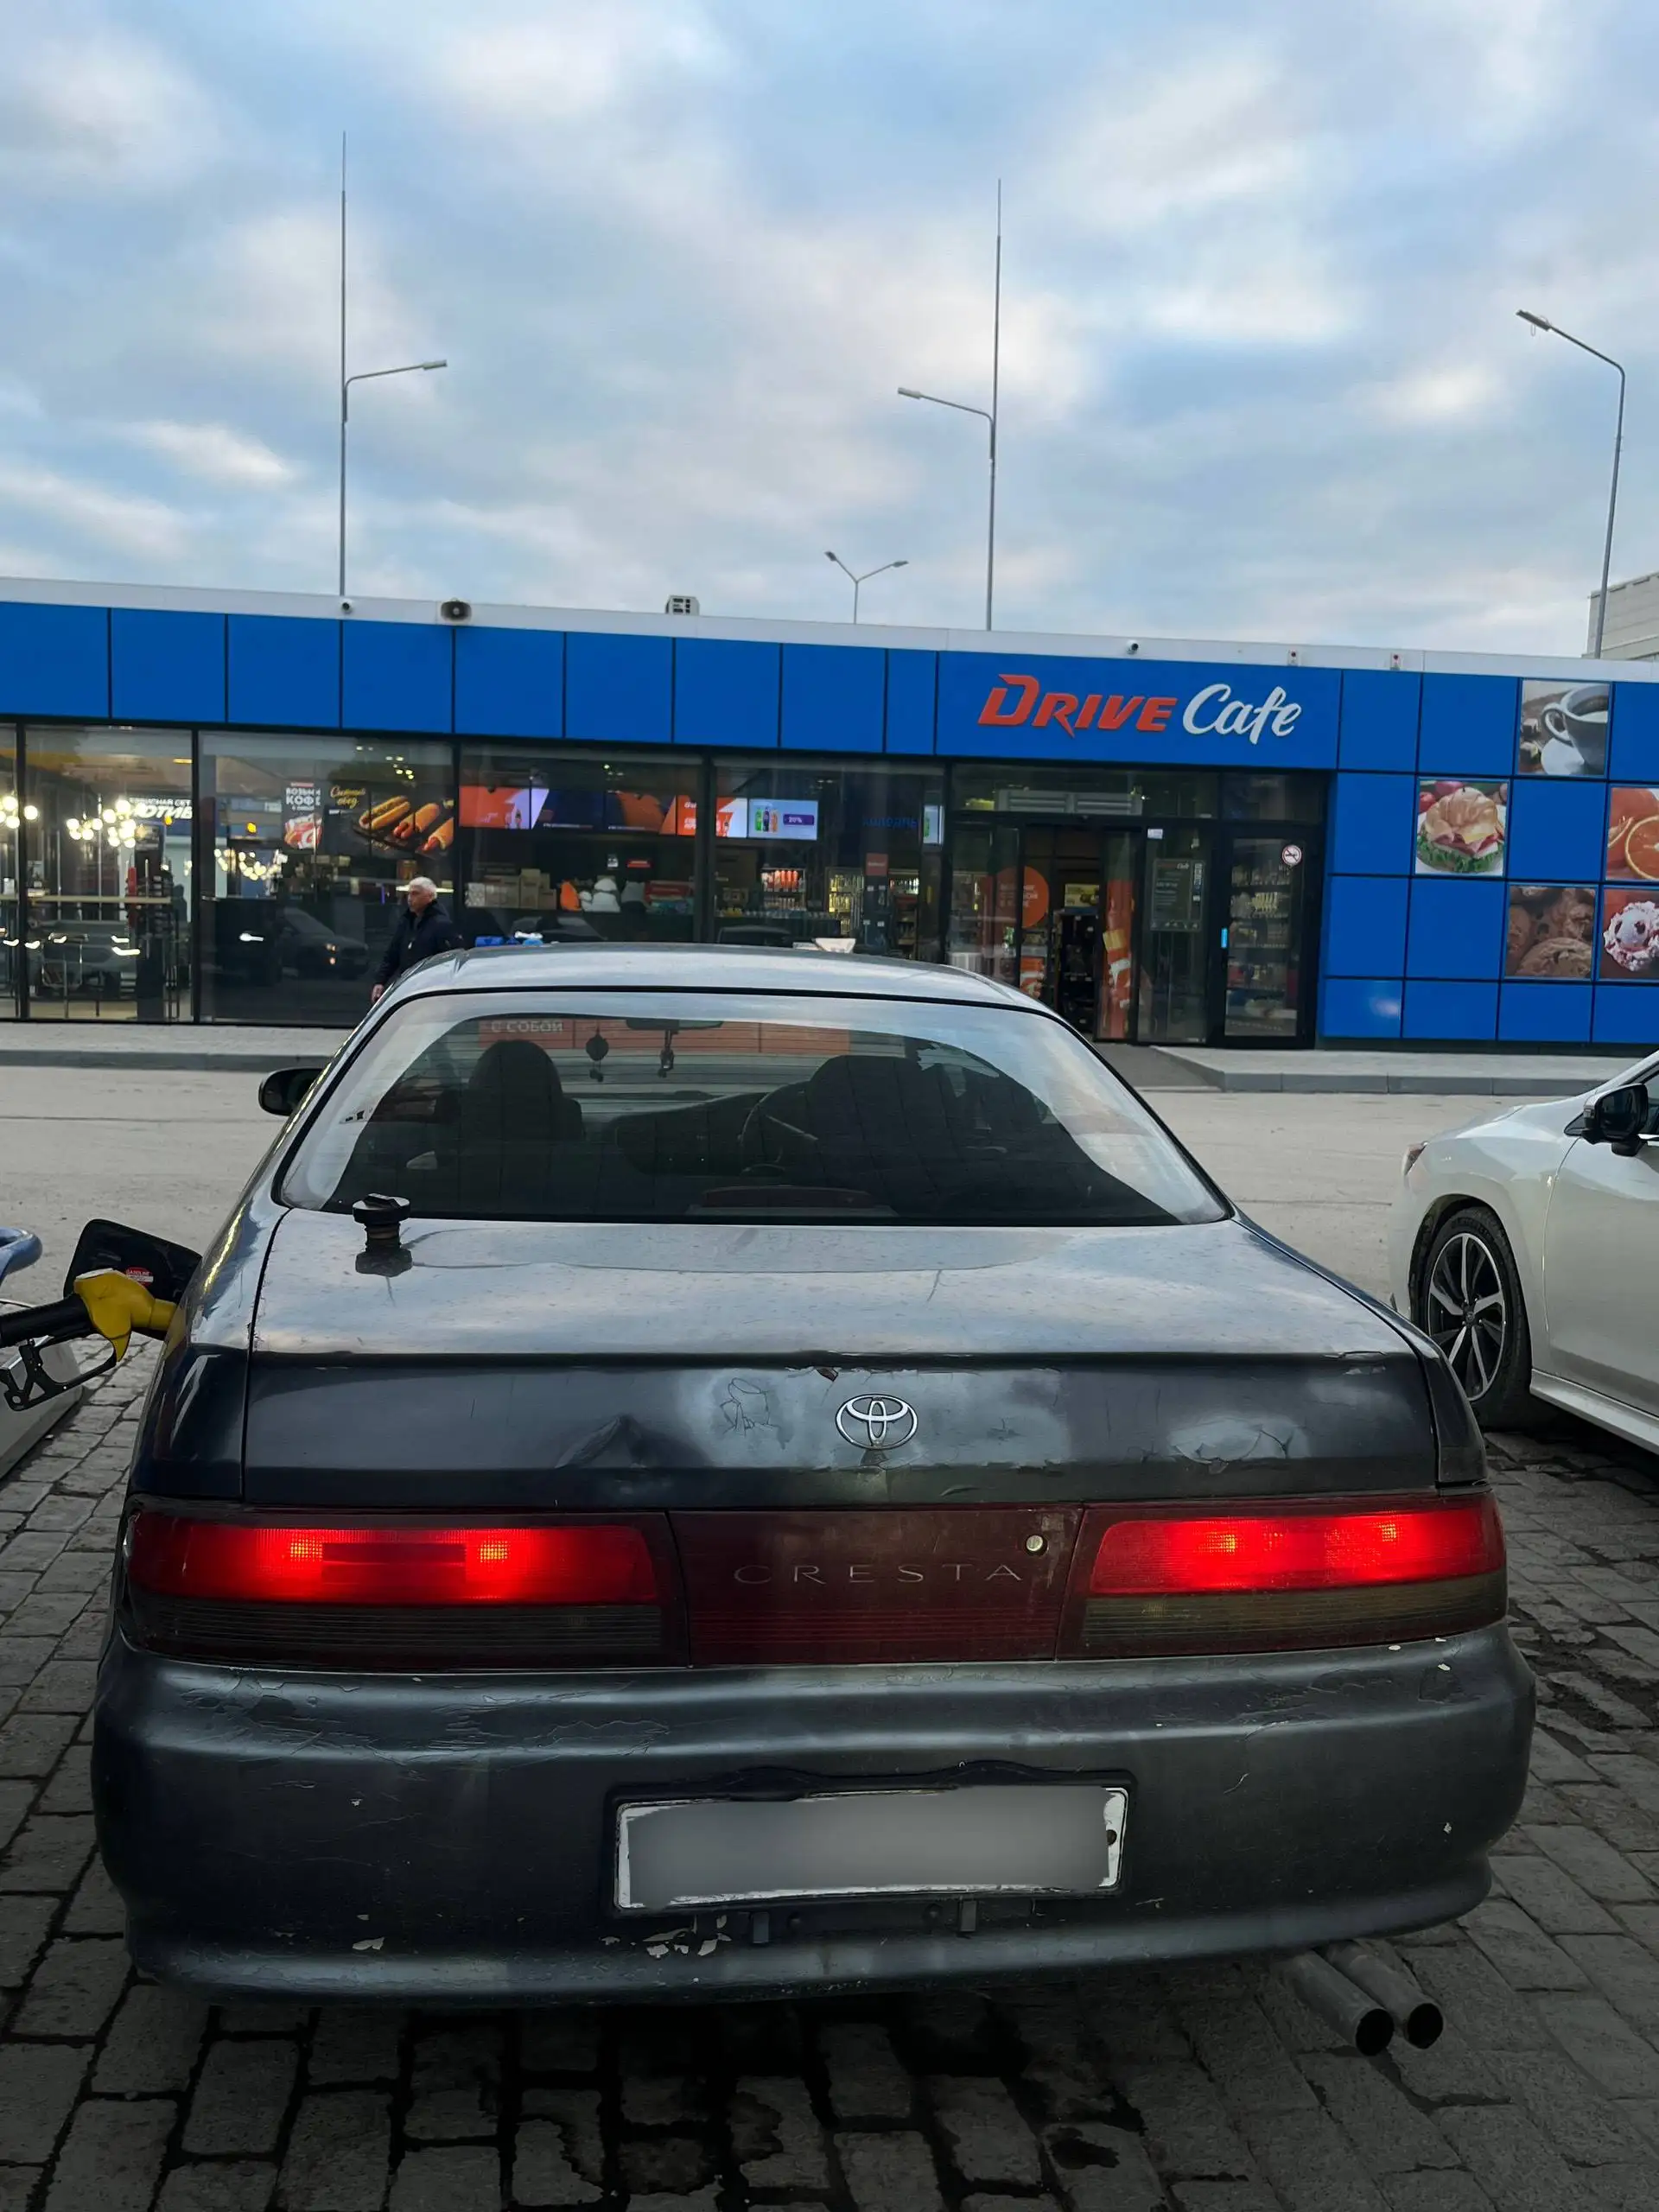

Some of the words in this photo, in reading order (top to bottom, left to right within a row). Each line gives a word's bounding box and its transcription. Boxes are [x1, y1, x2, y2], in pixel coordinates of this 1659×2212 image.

[977, 674, 1178, 739] DRIVE
[1182, 683, 1303, 745] Cafe
[733, 1563, 1023, 1585] CRESTA
